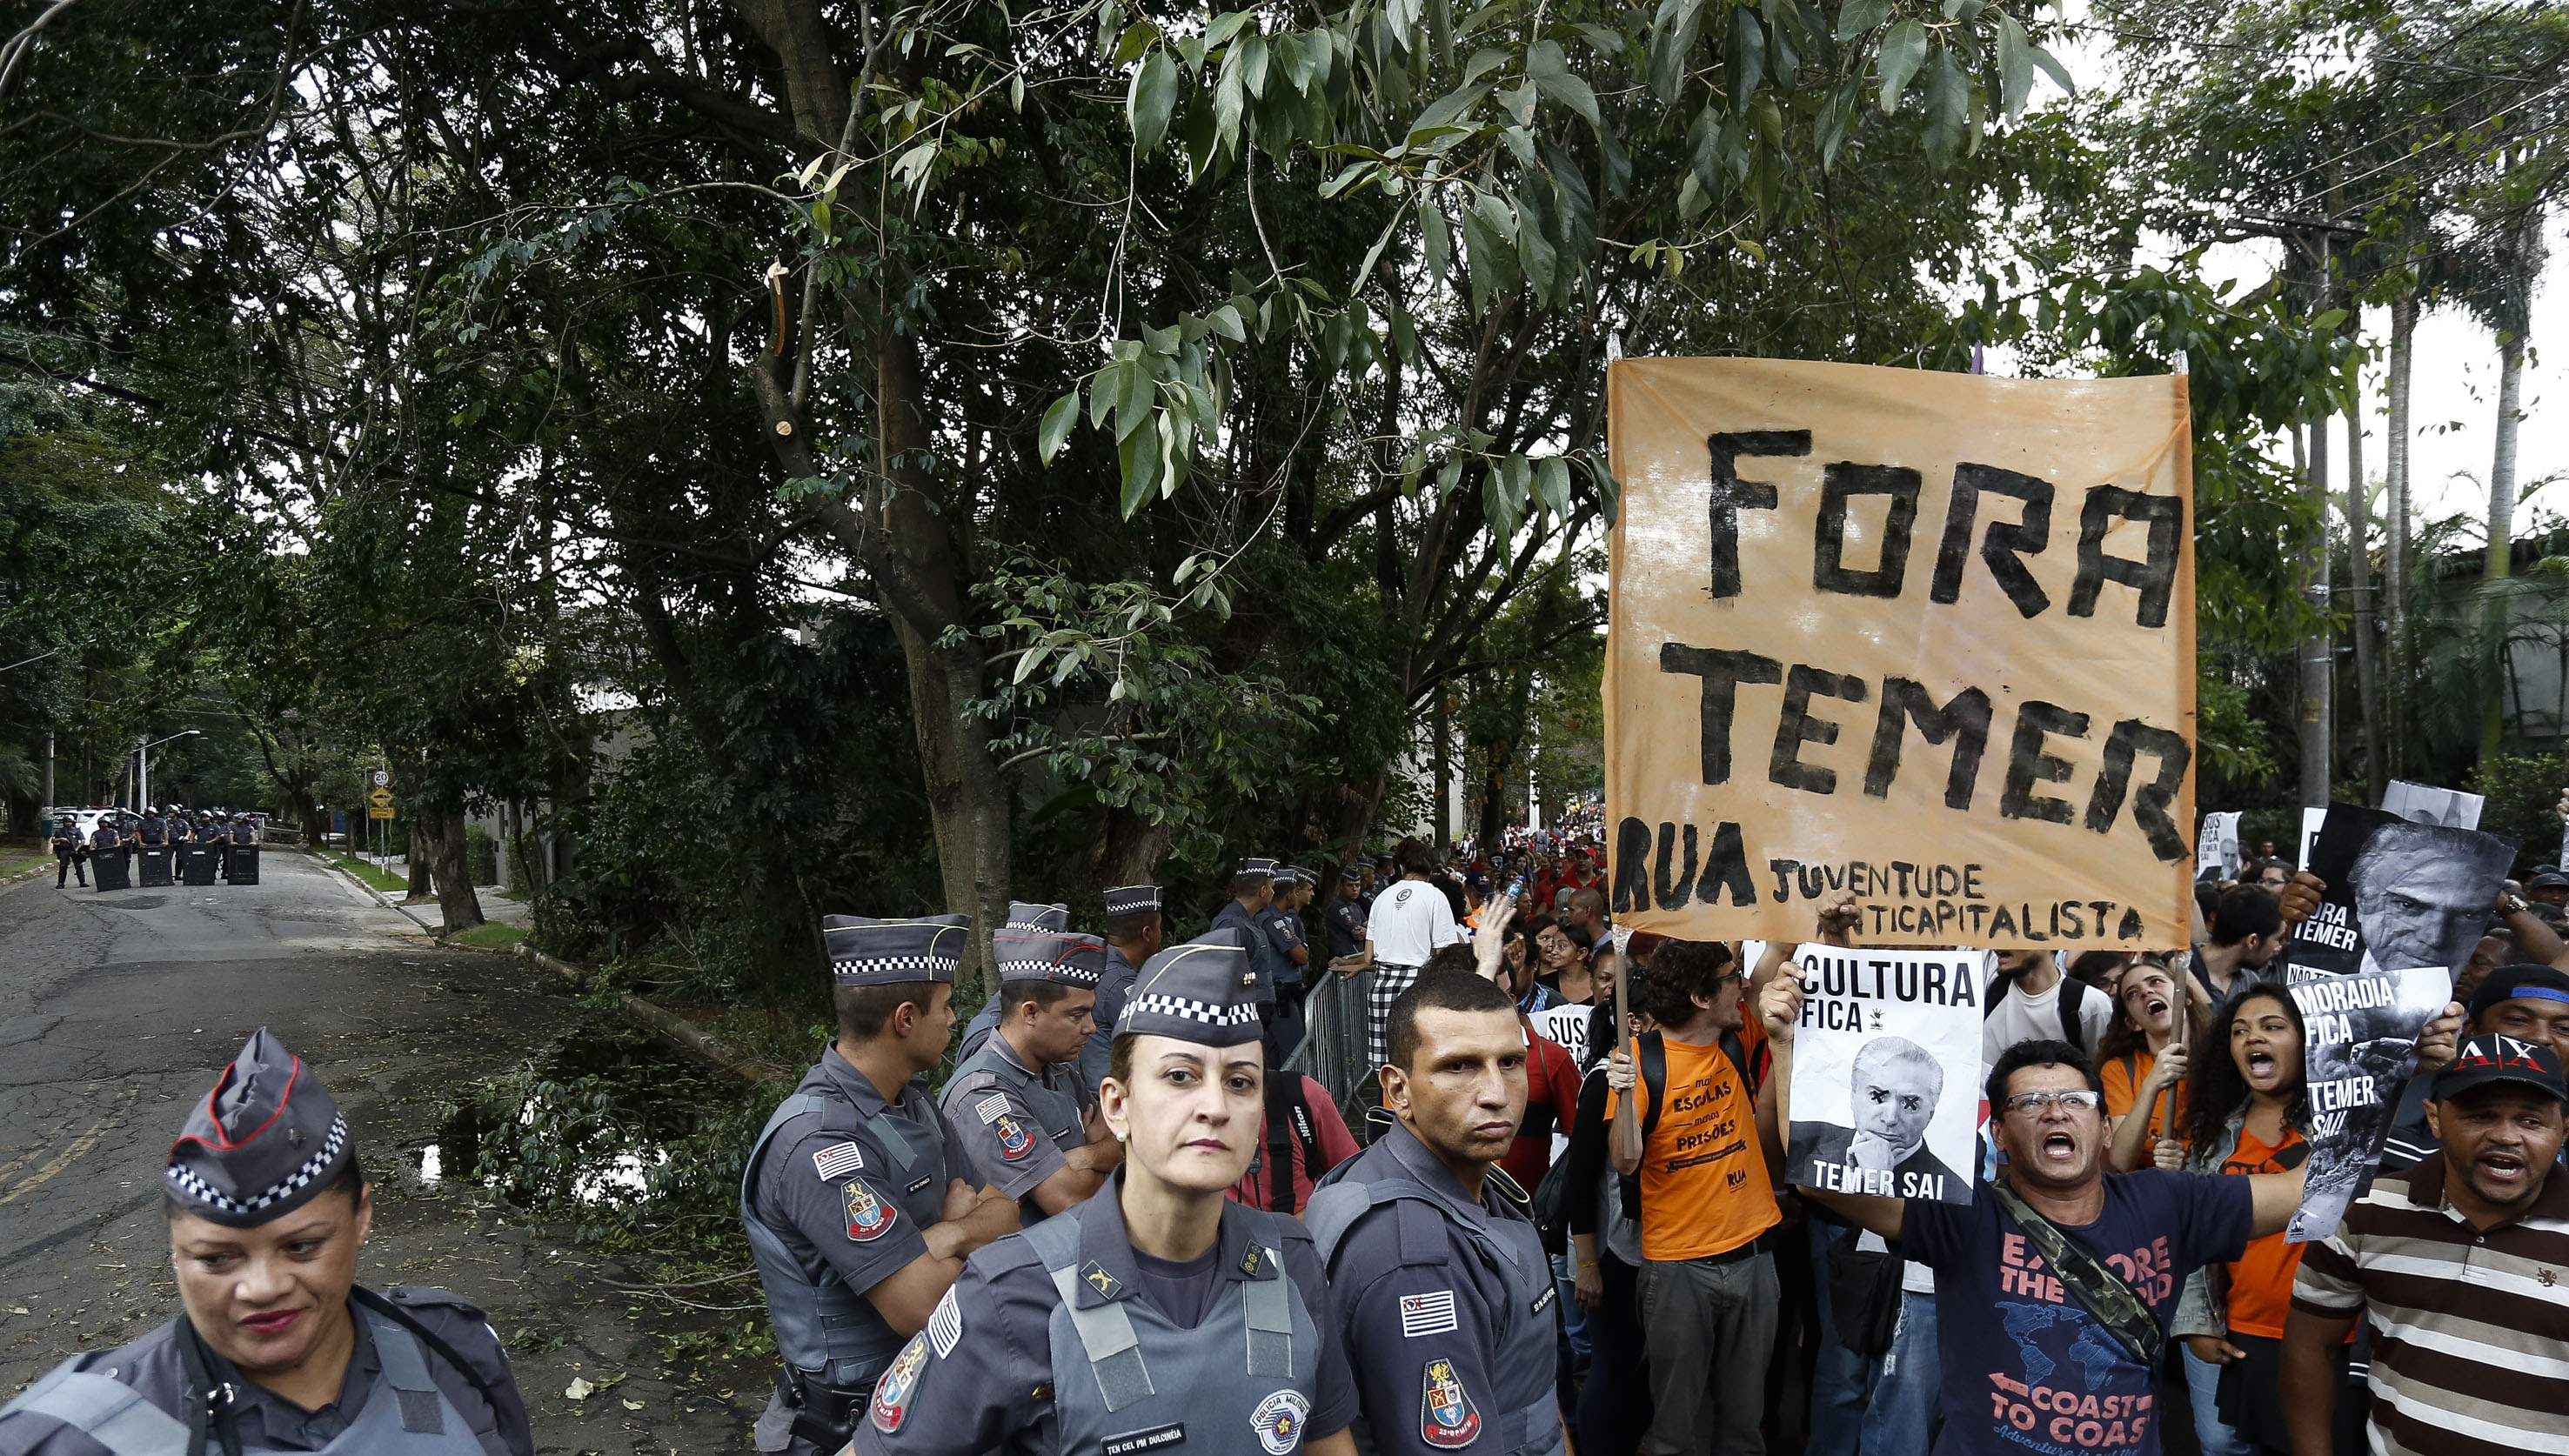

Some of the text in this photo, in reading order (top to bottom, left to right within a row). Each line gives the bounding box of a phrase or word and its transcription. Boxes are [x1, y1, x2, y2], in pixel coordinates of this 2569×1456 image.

[1708, 429, 2184, 628] FORA
[1660, 642, 2191, 865] TEMER
[2201, 830, 2218, 843] FICA
[2203, 813, 2221, 830] SUS
[1612, 816, 1757, 913] RUA
[1770, 858, 1984, 904] JUVENTUDE
[1816, 900, 2144, 941] TICAPITALISTA
[2310, 901, 2347, 927] ORA
[2294, 921, 2358, 952] TEMER
[1799, 954, 1976, 1007] CULTURA
[2289, 977, 2396, 1015] MORADIA
[1549, 1017, 1585, 1045] SUS
[1801, 998, 1863, 1033] FICA
[2303, 1013, 2353, 1047] FICA
[1673, 1080, 1732, 1112] ESCOLAS
[2307, 1075, 2375, 1112] TEMER
[1294, 1105, 1310, 1137] Nikon
[1676, 1119, 1736, 1152] PRISÕES
[1694, 1111, 1720, 1126] menos
[2311, 1110, 2348, 1143] SAI!
[1727, 1169, 1748, 1187] RUA
[1813, 1159, 1944, 1201] TEMER SAI
[2003, 1232, 2171, 1284] EORE
[2000, 1266, 2064, 1304] THE
[1991, 1392, 2150, 1446] TO COAS
[2031, 1386, 2136, 1419] COAST
[1107, 1428, 1181, 1456] TEN CEL PM DULCINÉIA
